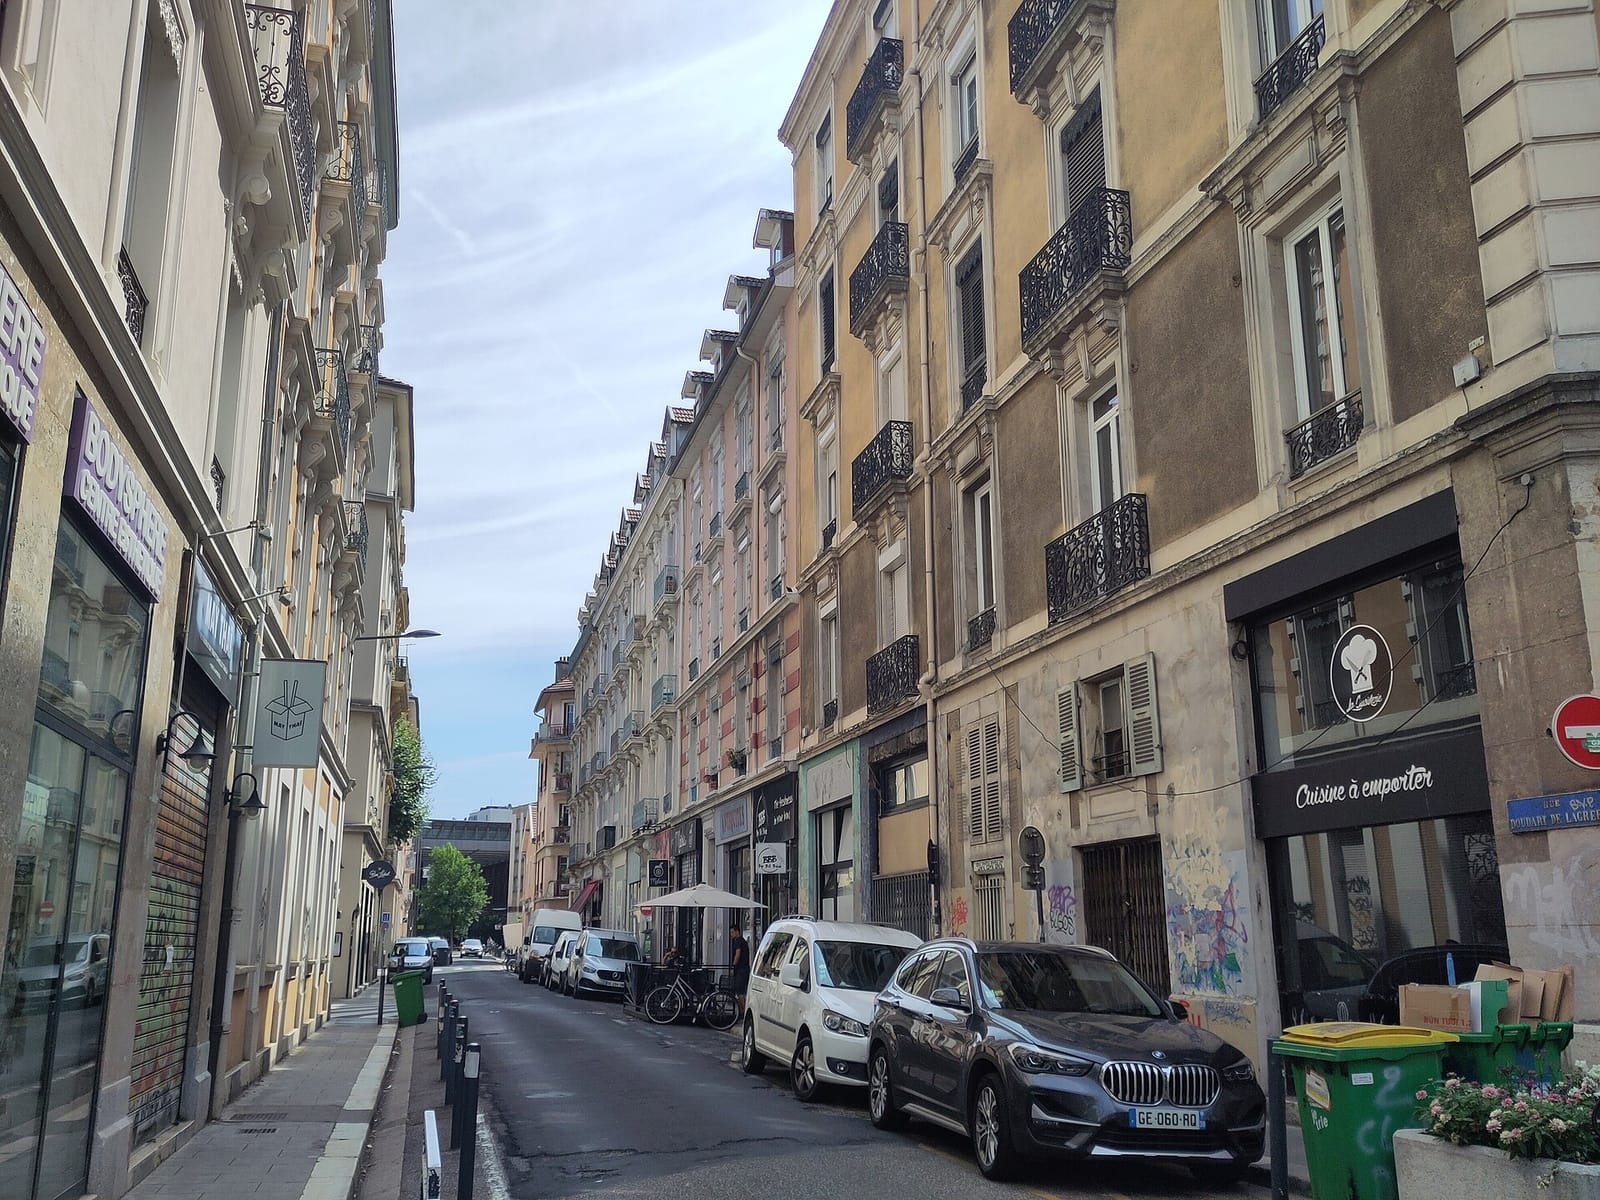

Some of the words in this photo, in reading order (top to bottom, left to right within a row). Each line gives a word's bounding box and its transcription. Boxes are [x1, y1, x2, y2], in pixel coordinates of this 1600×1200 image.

[0, 269, 46, 386] ERE
[79, 469, 121, 540] CENTRE
[83, 410, 168, 563] BODYSPHERE
[1296, 784, 1346, 809] Cuisine
[1349, 778, 1359, 799] à
[1362, 764, 1433, 801] emporter
[1543, 799, 1560, 809] RUE
[1510, 815, 1547, 829] DOUDART
[1551, 813, 1561, 824] DE
